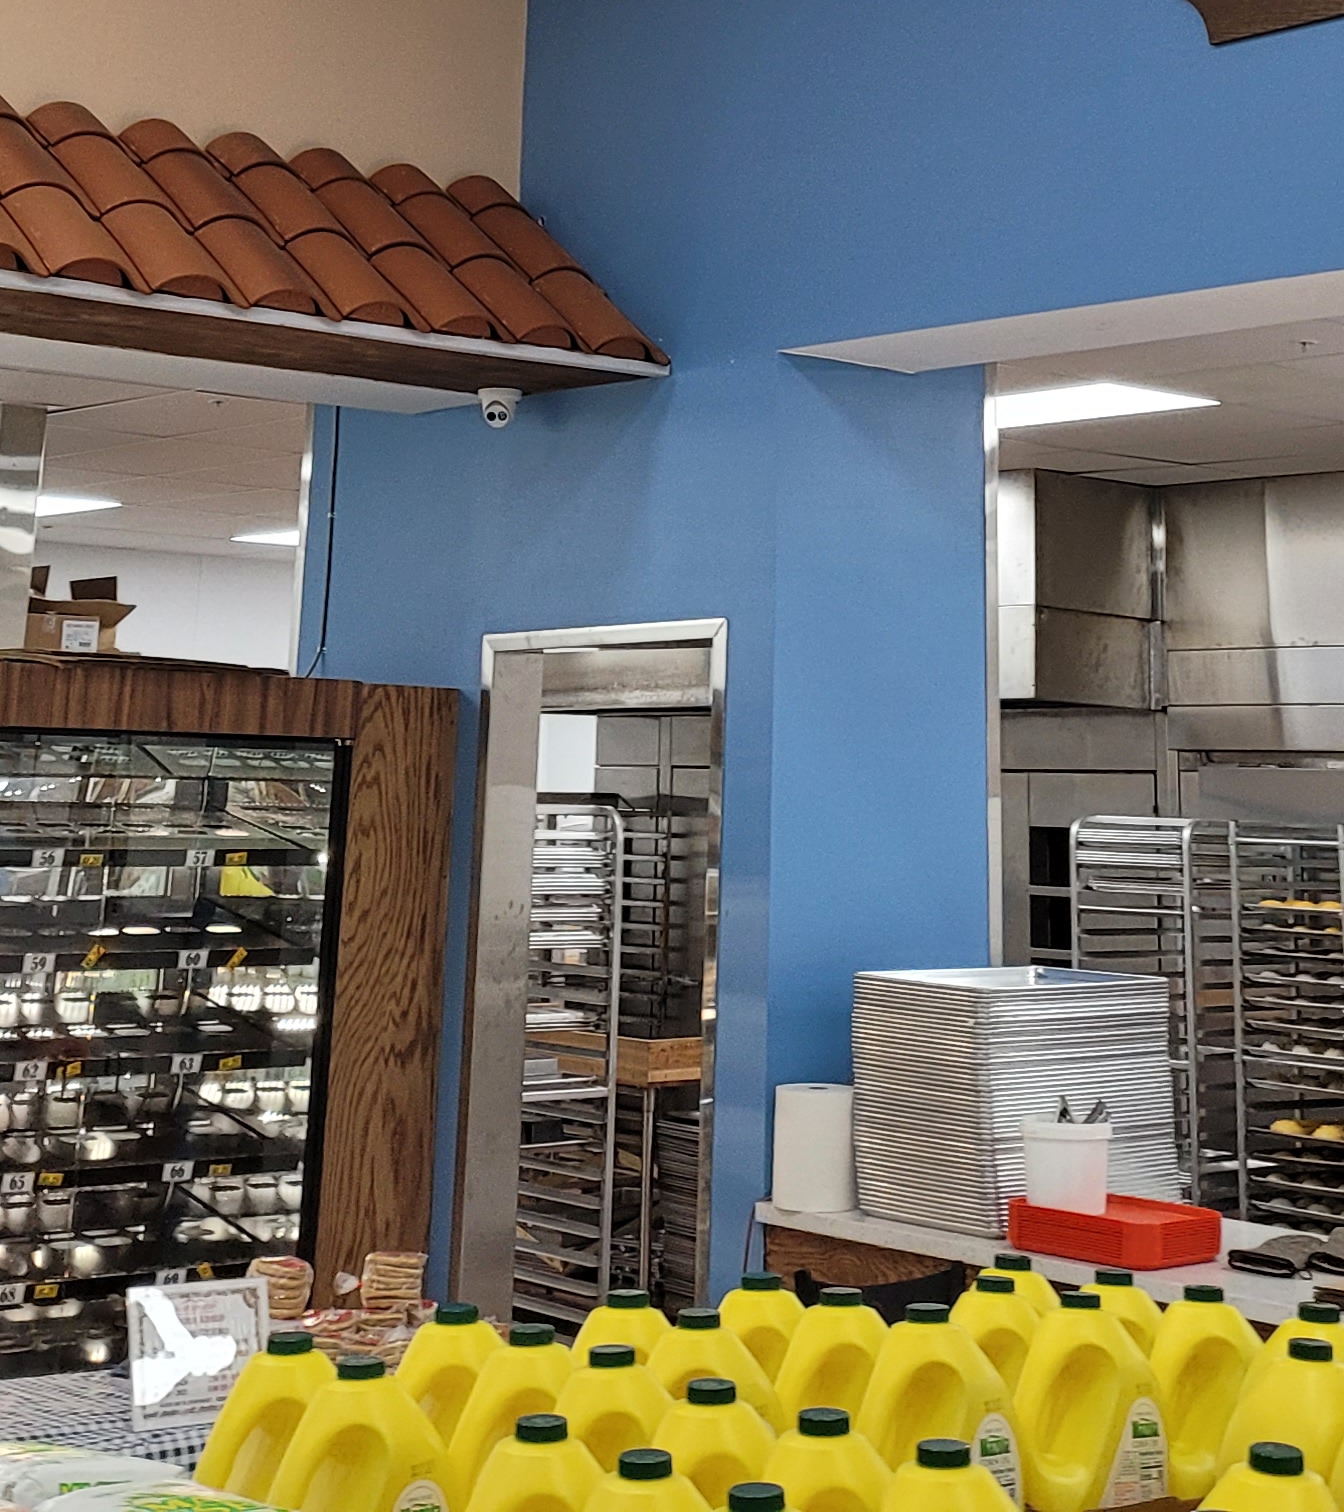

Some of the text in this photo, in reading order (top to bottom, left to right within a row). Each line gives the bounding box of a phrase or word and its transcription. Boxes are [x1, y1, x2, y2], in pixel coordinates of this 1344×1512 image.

[38, 850, 56, 866] 56
[193, 851, 208, 865] 57
[22, 1062, 40, 1079] 62
[9, 1174, 26, 1191] 65
